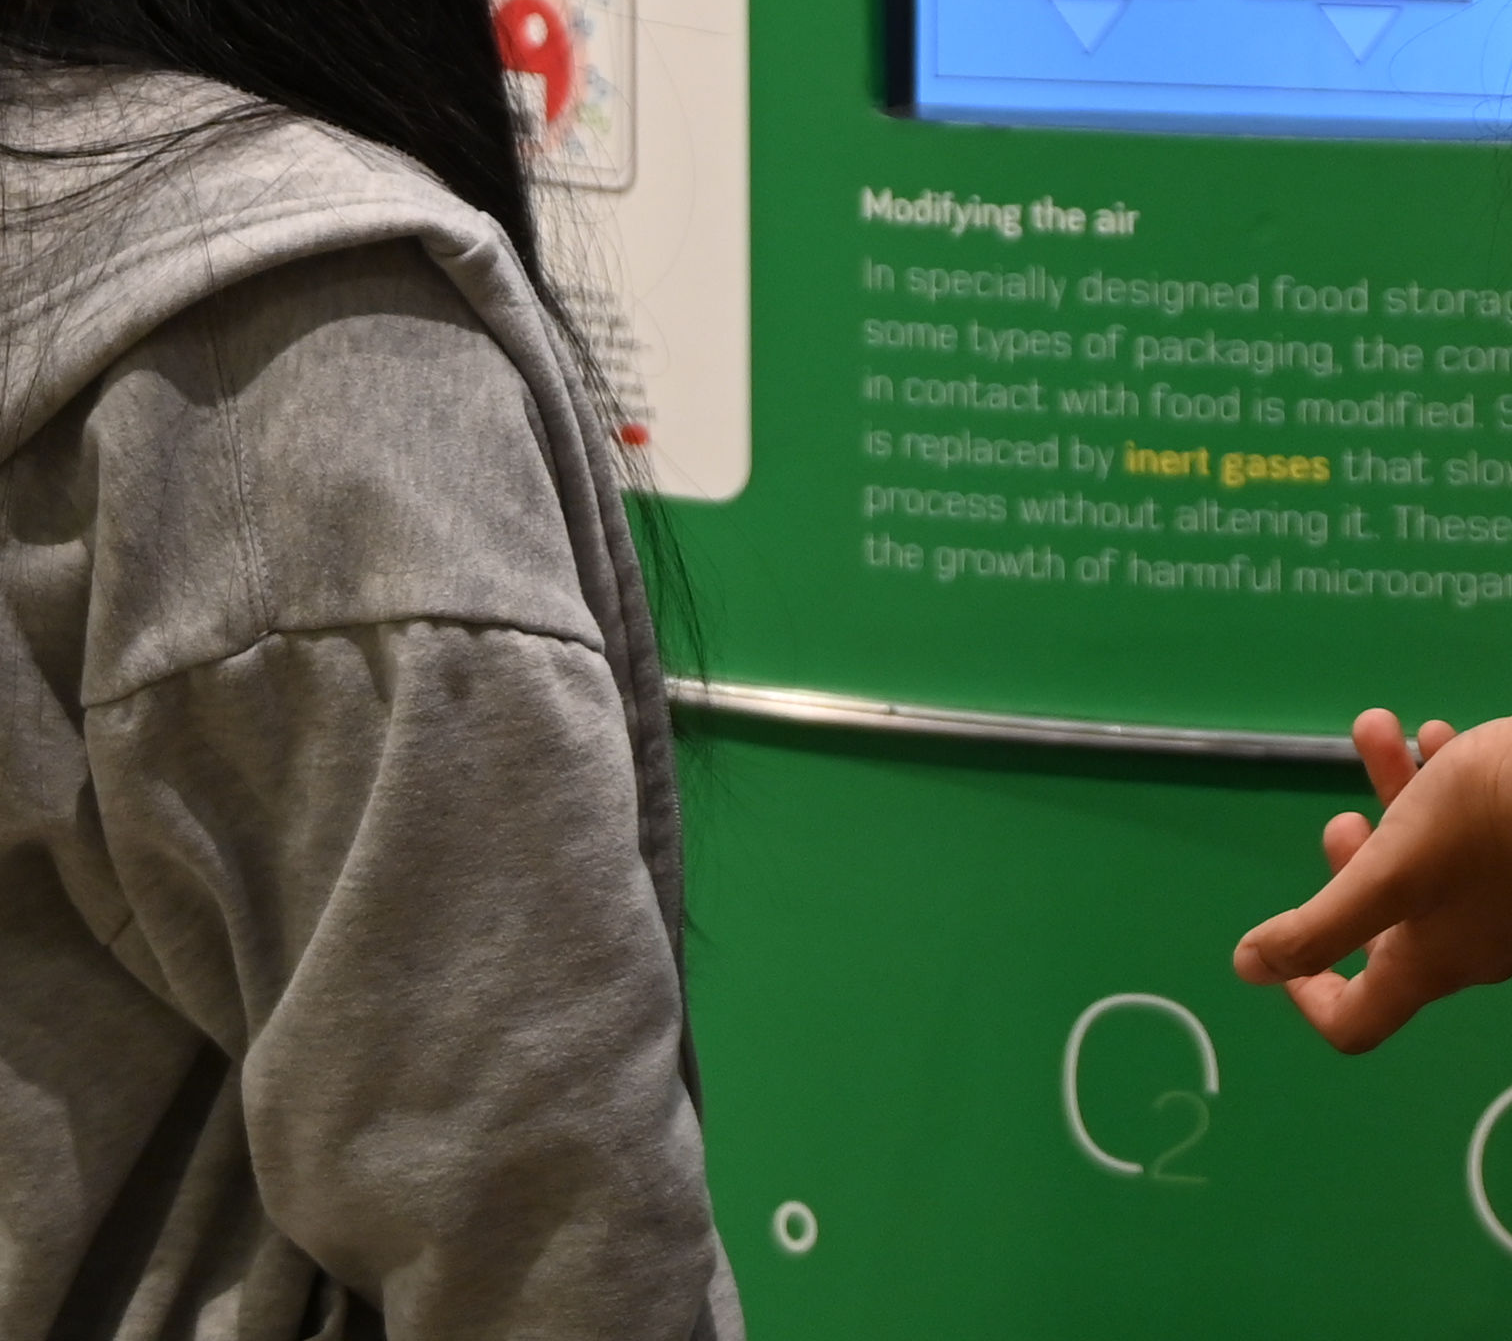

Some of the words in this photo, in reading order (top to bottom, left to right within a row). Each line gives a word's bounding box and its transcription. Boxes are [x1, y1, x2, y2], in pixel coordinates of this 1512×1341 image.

[860, 186, 1023, 241] Modifying
[1030, 195, 1087, 233] the
[1094, 201, 1140, 236] air
[864, 257, 895, 291] In
[906, 263, 1068, 310] specially
[1079, 269, 1259, 316] designed
[1273, 274, 1370, 313] food
[865, 319, 959, 351] some
[968, 318, 1073, 363] types
[1083, 323, 1129, 360] of
[1134, 329, 1343, 378] packaging,
[1355, 335, 1425, 371] the
[863, 369, 894, 402] in
[901, 374, 1048, 413] contact
[1058, 381, 1140, 416] with
[1149, 381, 1240, 421] food
[1253, 388, 1286, 424] is
[1295, 388, 1484, 429] modified.
[864, 423, 893, 458] is
[901, 428, 1060, 469] replaced
[1069, 434, 1115, 480] by
[1124, 439, 1211, 477] inert
[1220, 450, 1331, 489] gases
[1340, 447, 1434, 486] that
[863, 483, 1008, 520] process
[1018, 490, 1164, 531] without
[1174, 495, 1330, 546] altering
[863, 532, 925, 569] the
[933, 545, 1066, 584] growth
[1078, 547, 1120, 584] of
[1128, 550, 1282, 592] harmful
